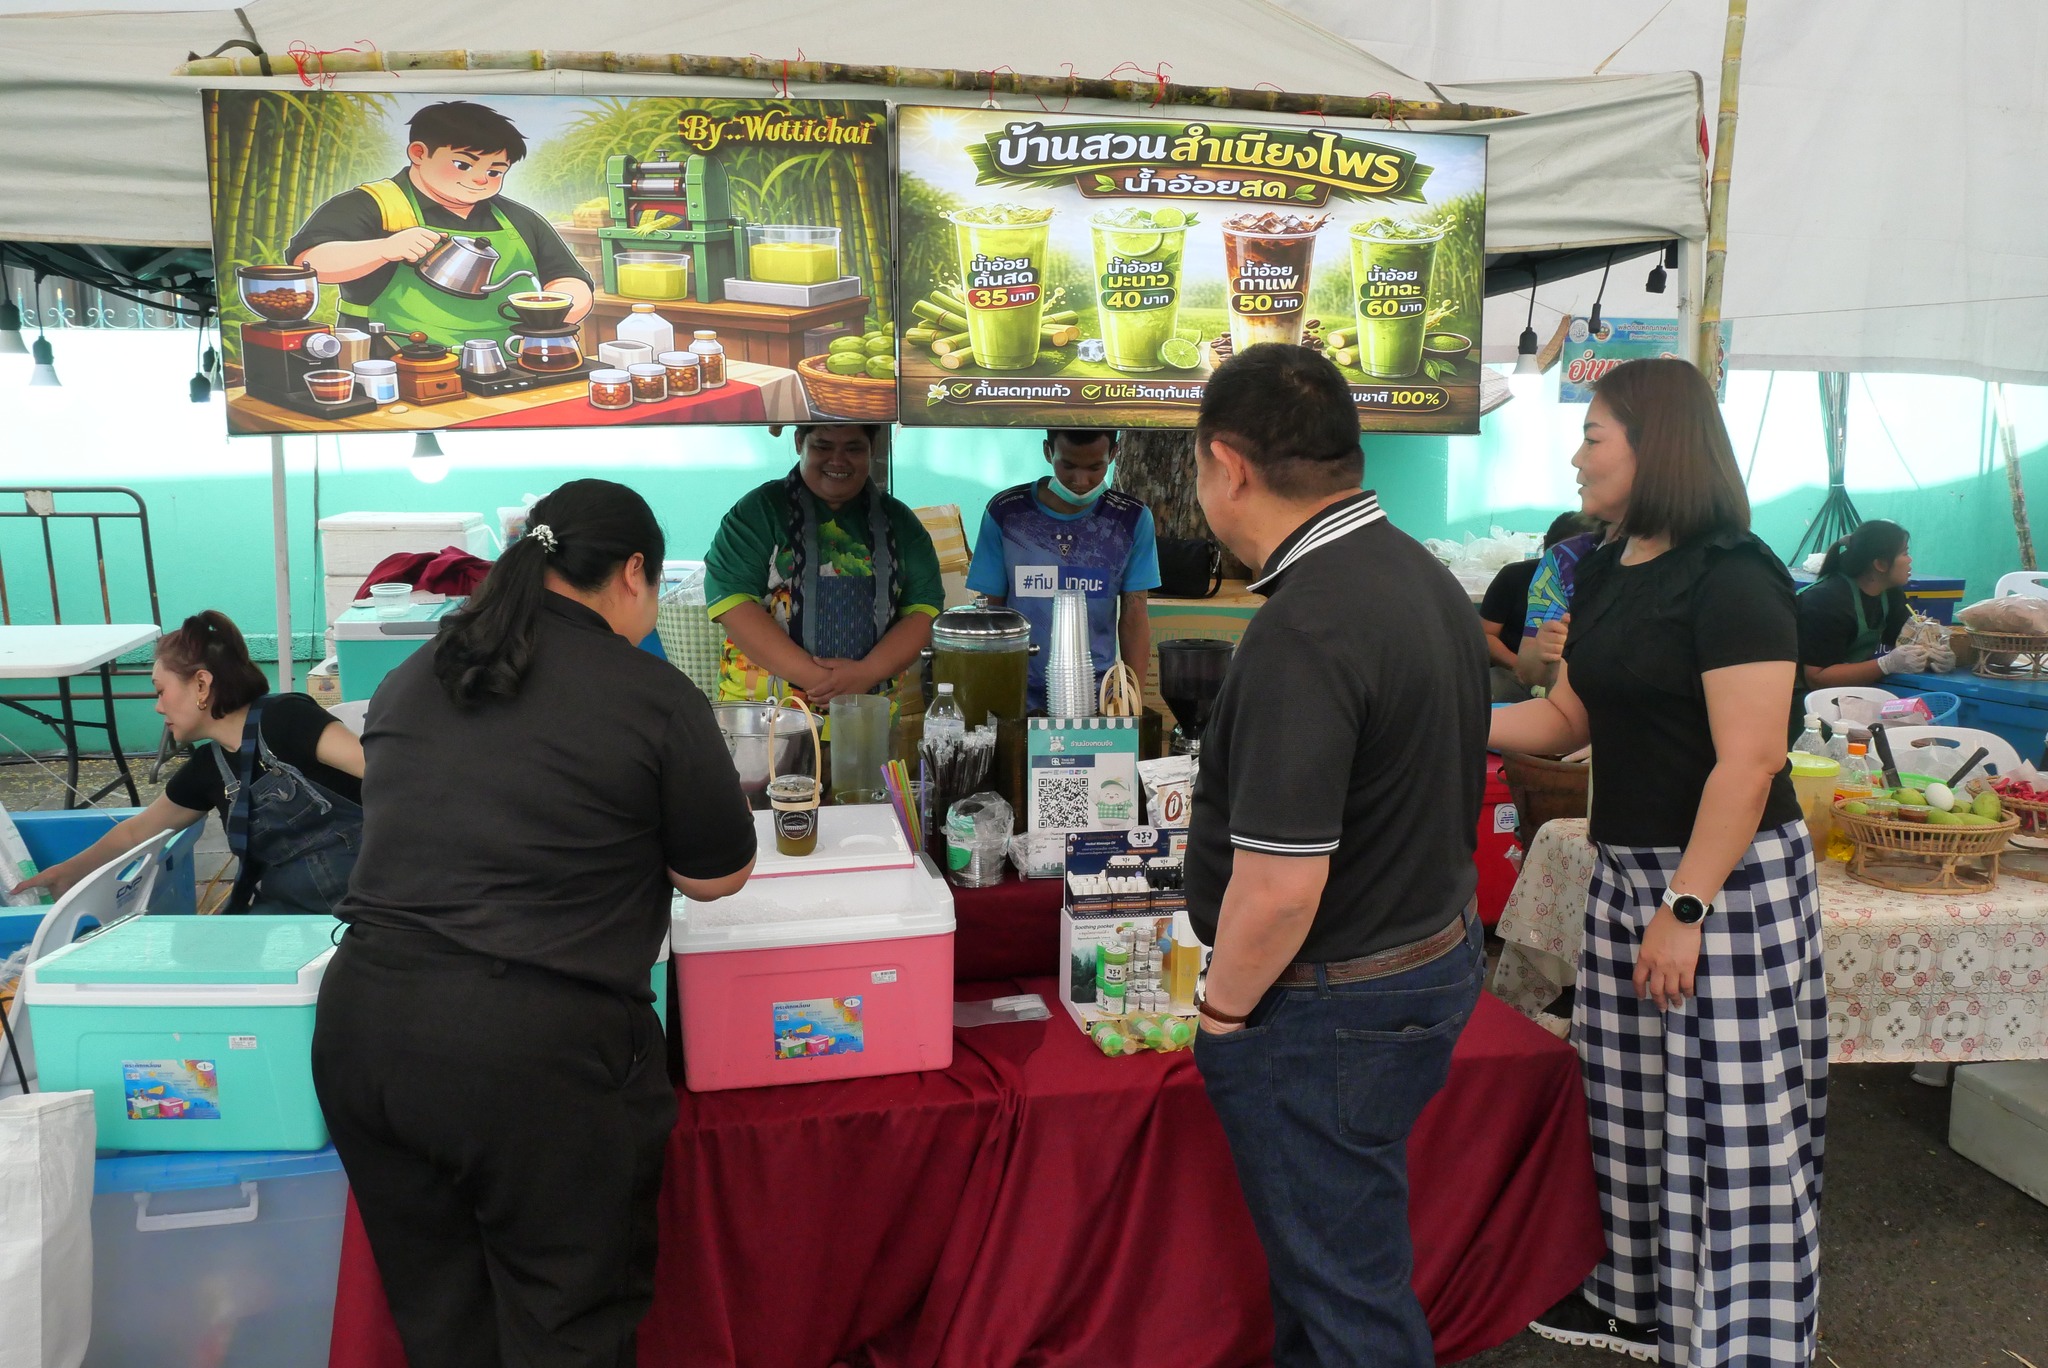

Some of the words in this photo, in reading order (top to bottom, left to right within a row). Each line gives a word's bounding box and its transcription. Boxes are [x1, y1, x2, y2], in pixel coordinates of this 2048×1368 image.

[1125, 168, 1286, 199] น้ำอ้อยสด
[971, 254, 1029, 272] น้ำอ้อย
[1107, 257, 1163, 275] น้ำอ้อย
[1240, 261, 1293, 277] น้ำอ้อย
[1108, 274, 1170, 288] มะนาว
[1367, 265, 1418, 282] น้ำอ้อย
[1239, 275, 1299, 291] กาแฟ
[975, 289, 1008, 307] 35
[1010, 291, 1035, 302] บาท
[1106, 291, 1141, 308] 40
[1143, 294, 1169, 305] บาท
[1239, 295, 1272, 311] 50
[1273, 298, 1298, 309] บาท
[1366, 300, 1399, 316] 60
[1400, 302, 1422, 312] บาท
[975, 380, 1071, 400] คั้นสดทุกแก้ว
[1391, 391, 1440, 405] 100%
